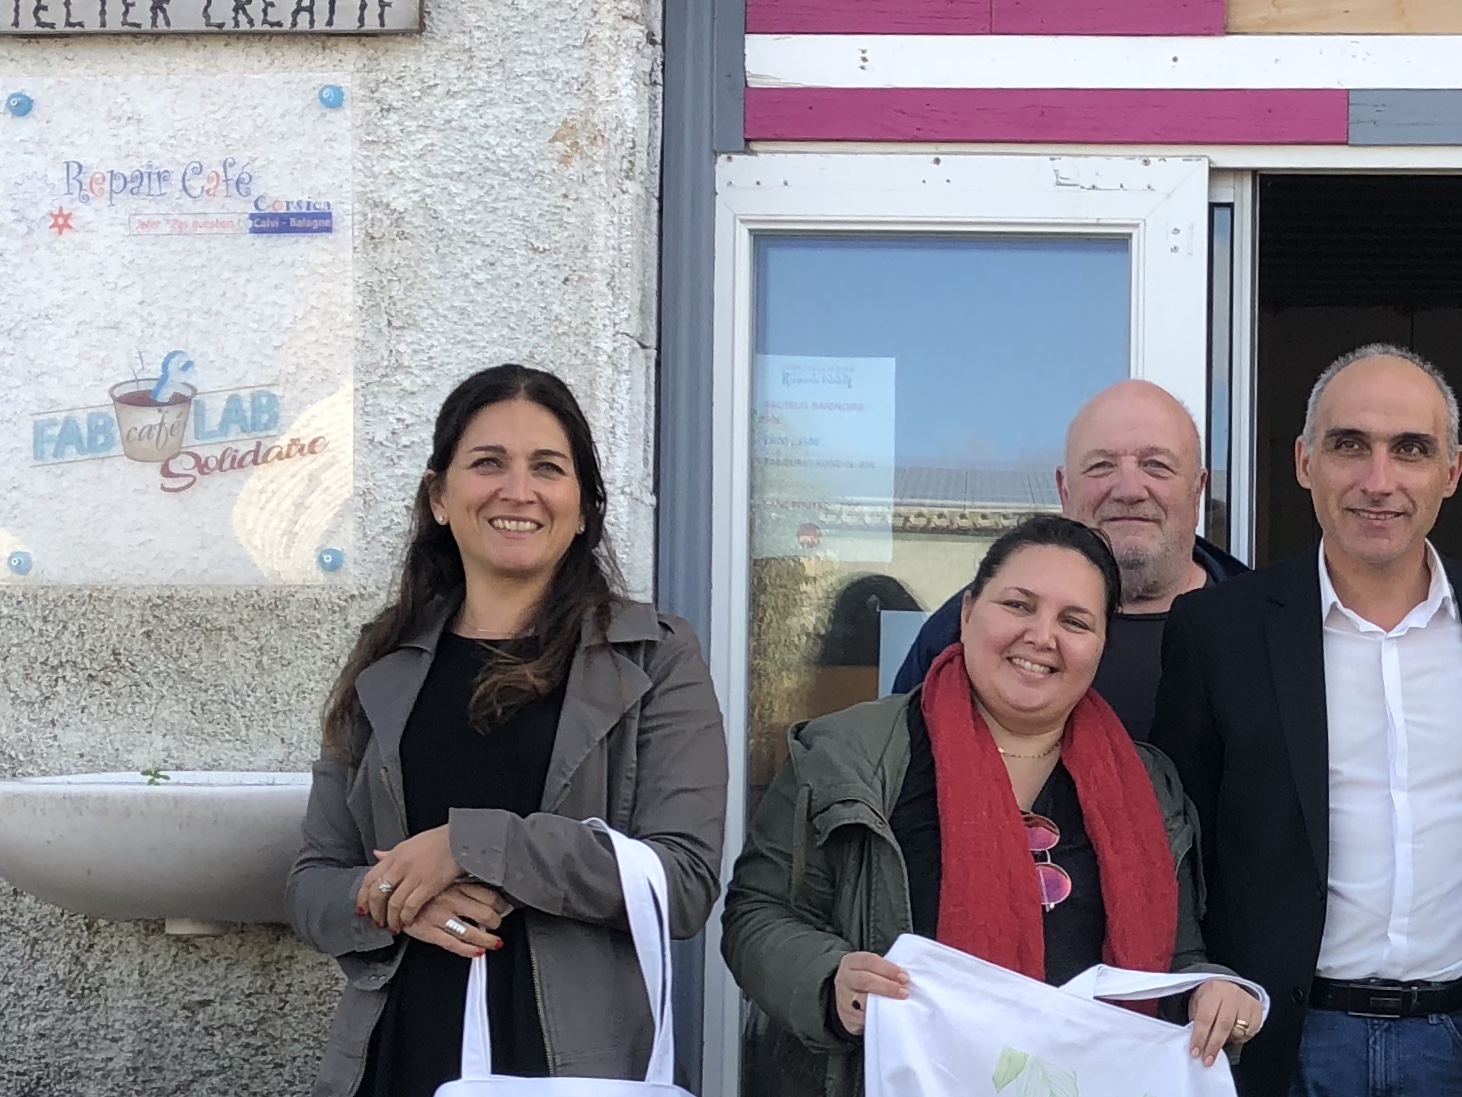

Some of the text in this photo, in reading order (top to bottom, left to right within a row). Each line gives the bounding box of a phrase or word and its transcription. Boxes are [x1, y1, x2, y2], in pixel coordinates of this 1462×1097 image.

[63, 156, 252, 207] Repair Café
[253, 195, 332, 212] Corsica
[32, 389, 281, 462] FAB café LAB
[160, 435, 330, 493] Solidaire
